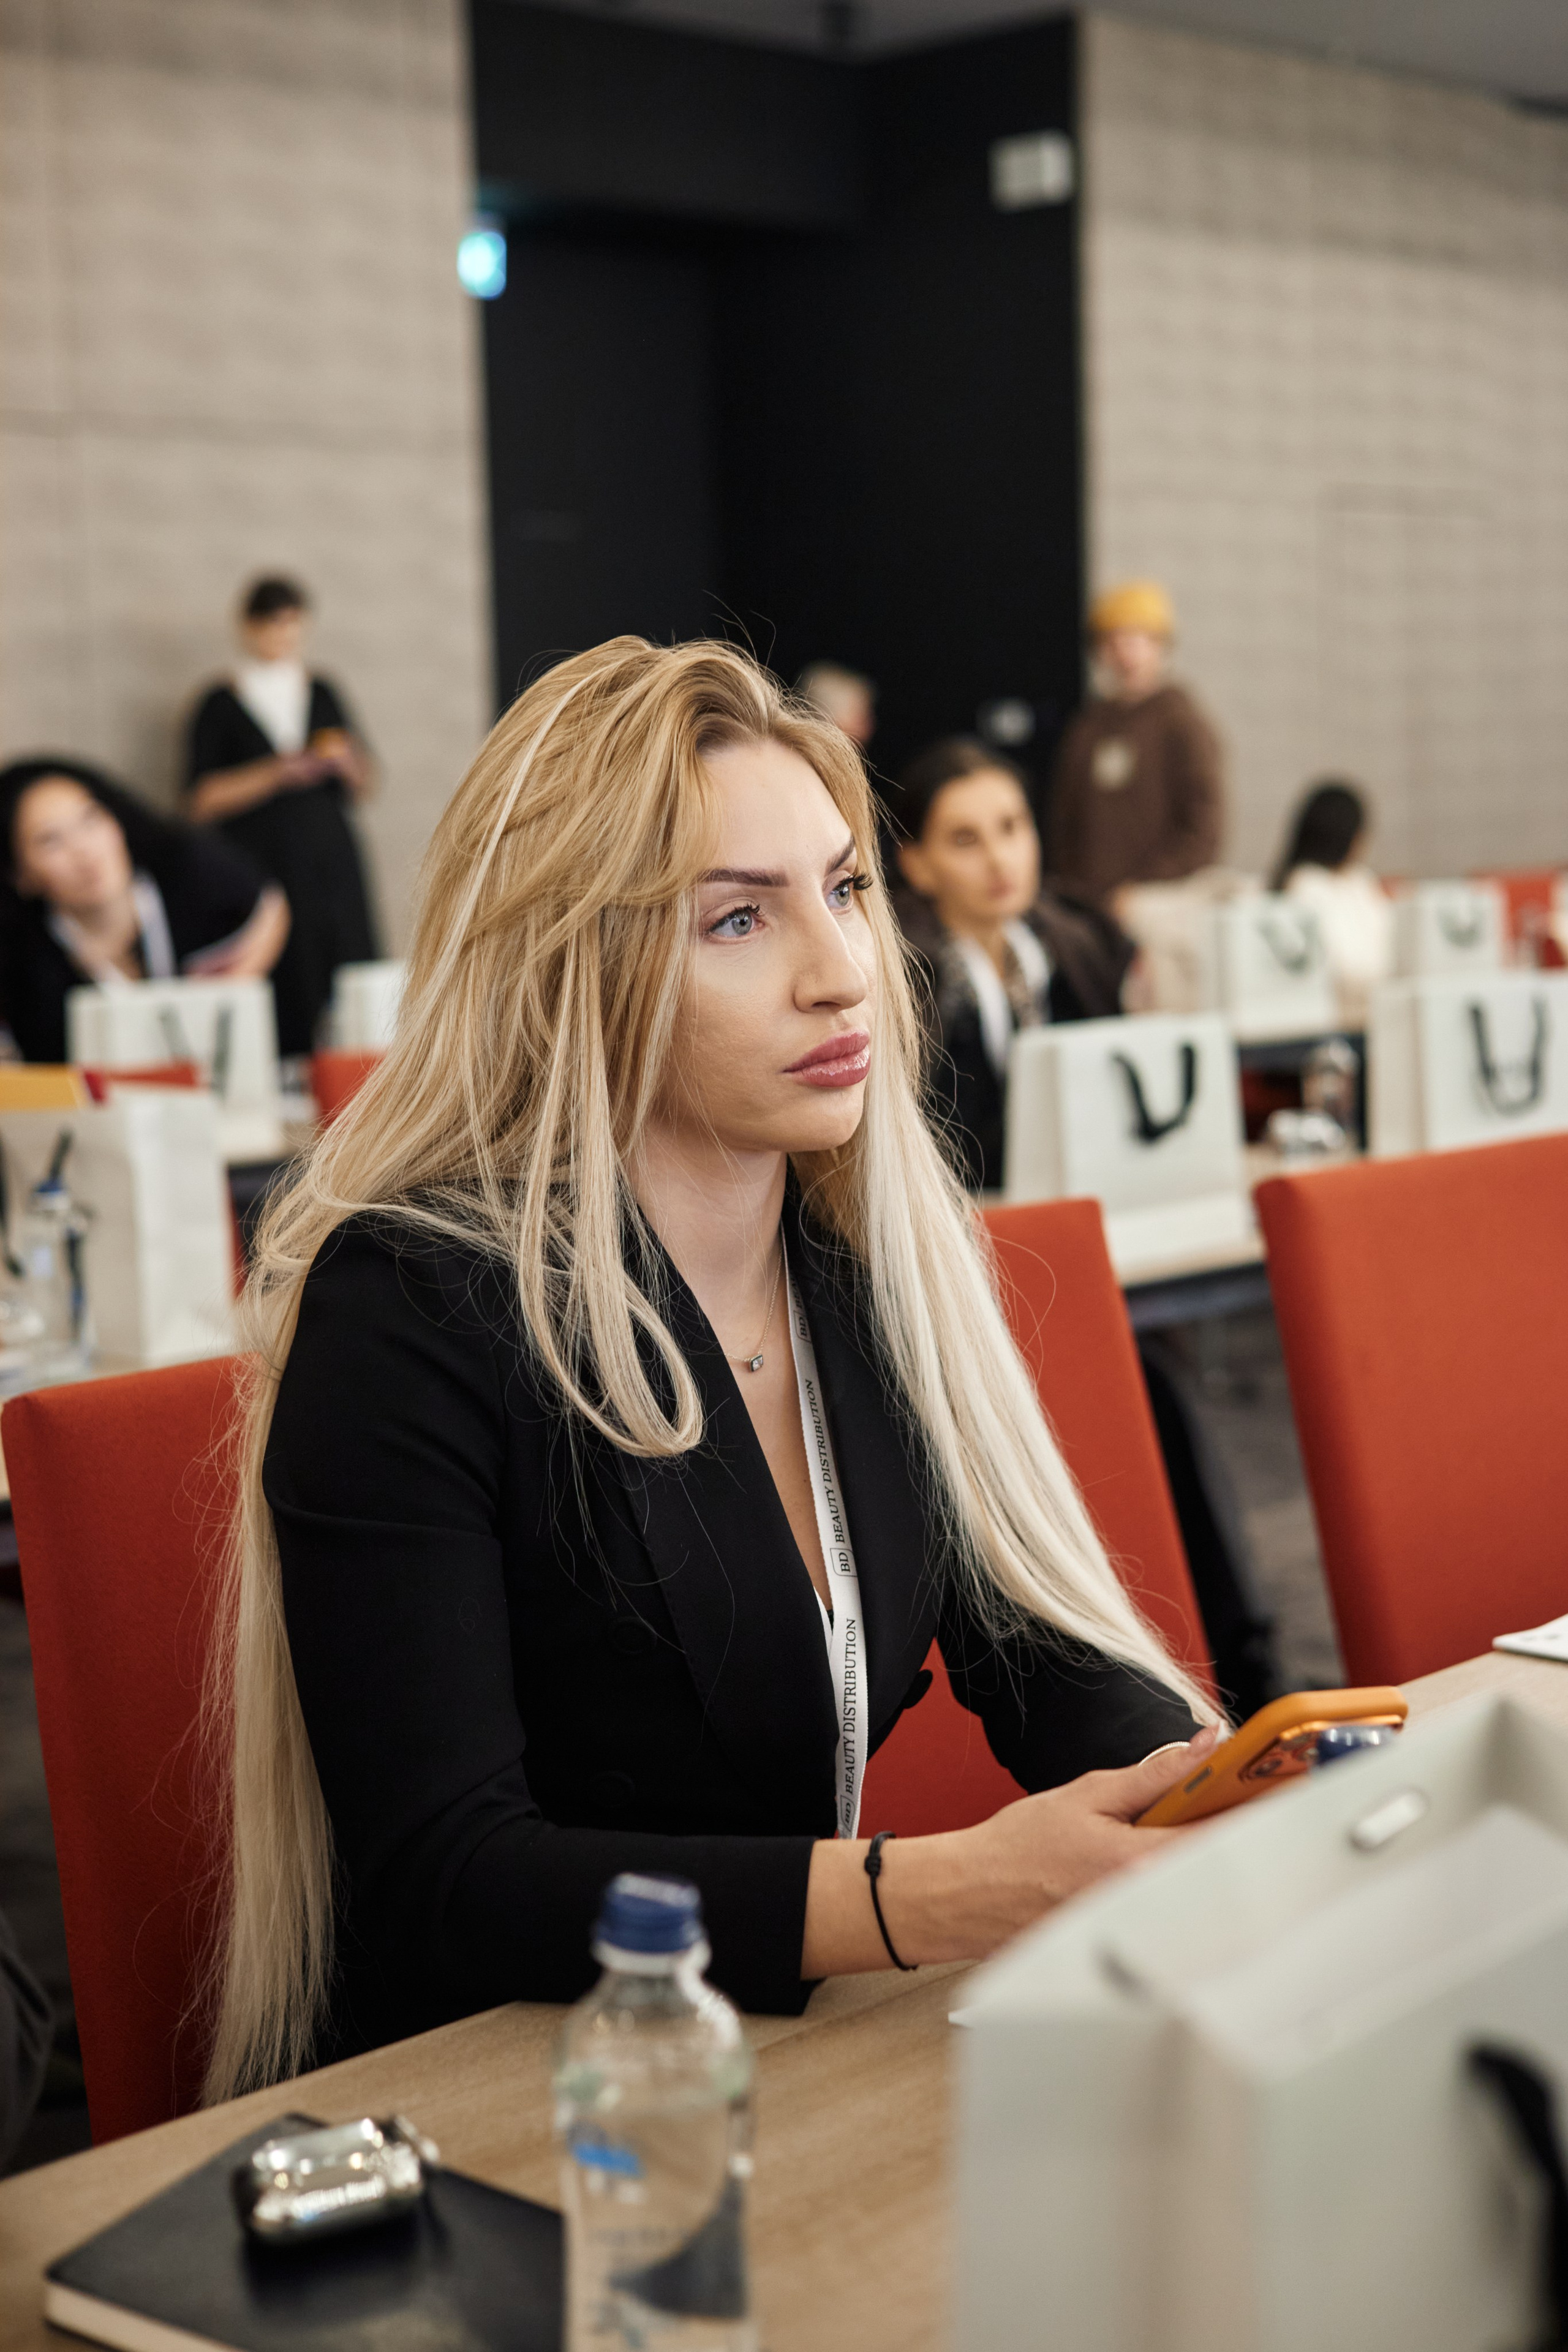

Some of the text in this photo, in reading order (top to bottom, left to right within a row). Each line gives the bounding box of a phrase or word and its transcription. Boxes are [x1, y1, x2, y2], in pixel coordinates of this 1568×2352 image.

[799, 1316, 807, 1336] BD
[805, 1379, 851, 1572] BD BEAUTY DISTRIBUTION
[843, 1618, 856, 1823] BD BEAUTY DISTRIBUTION
